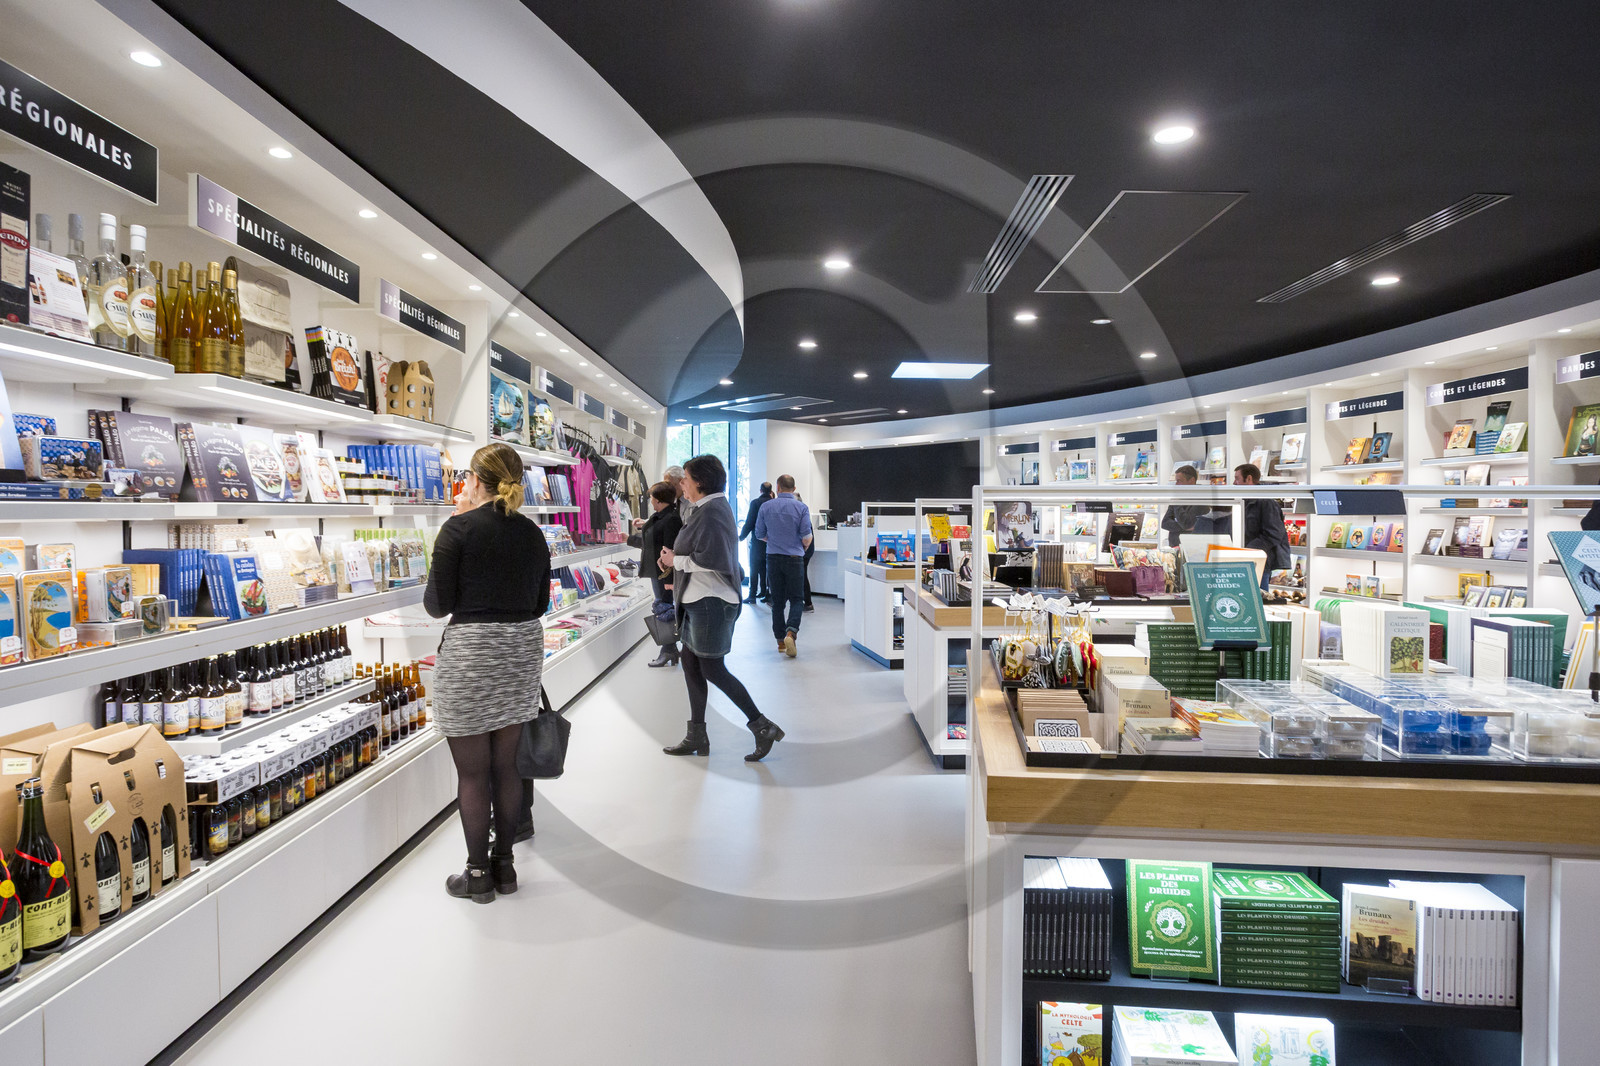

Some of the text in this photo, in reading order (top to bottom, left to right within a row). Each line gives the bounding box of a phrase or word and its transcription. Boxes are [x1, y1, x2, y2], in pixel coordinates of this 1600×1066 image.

[0, 84, 132, 170] RÉGIONALES
[208, 198, 349, 285] SPÉCIALITÉS RÉGIONALES
[384, 292, 460, 341] SPÉCIALITÉS RÉGIONALES
[1562, 360, 1595, 374] BANDES
[1429, 377, 1506, 399] CONTES ET LÉGENDES
[1349, 404, 1357, 412] ET
[1358, 399, 1388, 410] LÉGENDES
[149, 425, 175, 441] PALÉO
[1001, 512, 1032, 525] MERLIN
[1125, 702, 1152, 710] Brunaux
[1139, 871, 1200, 883] LES PLANTES
[1161, 880, 1179, 888] DES
[1148, 886, 1191, 896] DRUIDES
[1359, 909, 1392, 919] Brunaux
[1060, 1013, 1092, 1021] MYTHOLOGIE
[1061, 1019, 1083, 1027] CELTE
